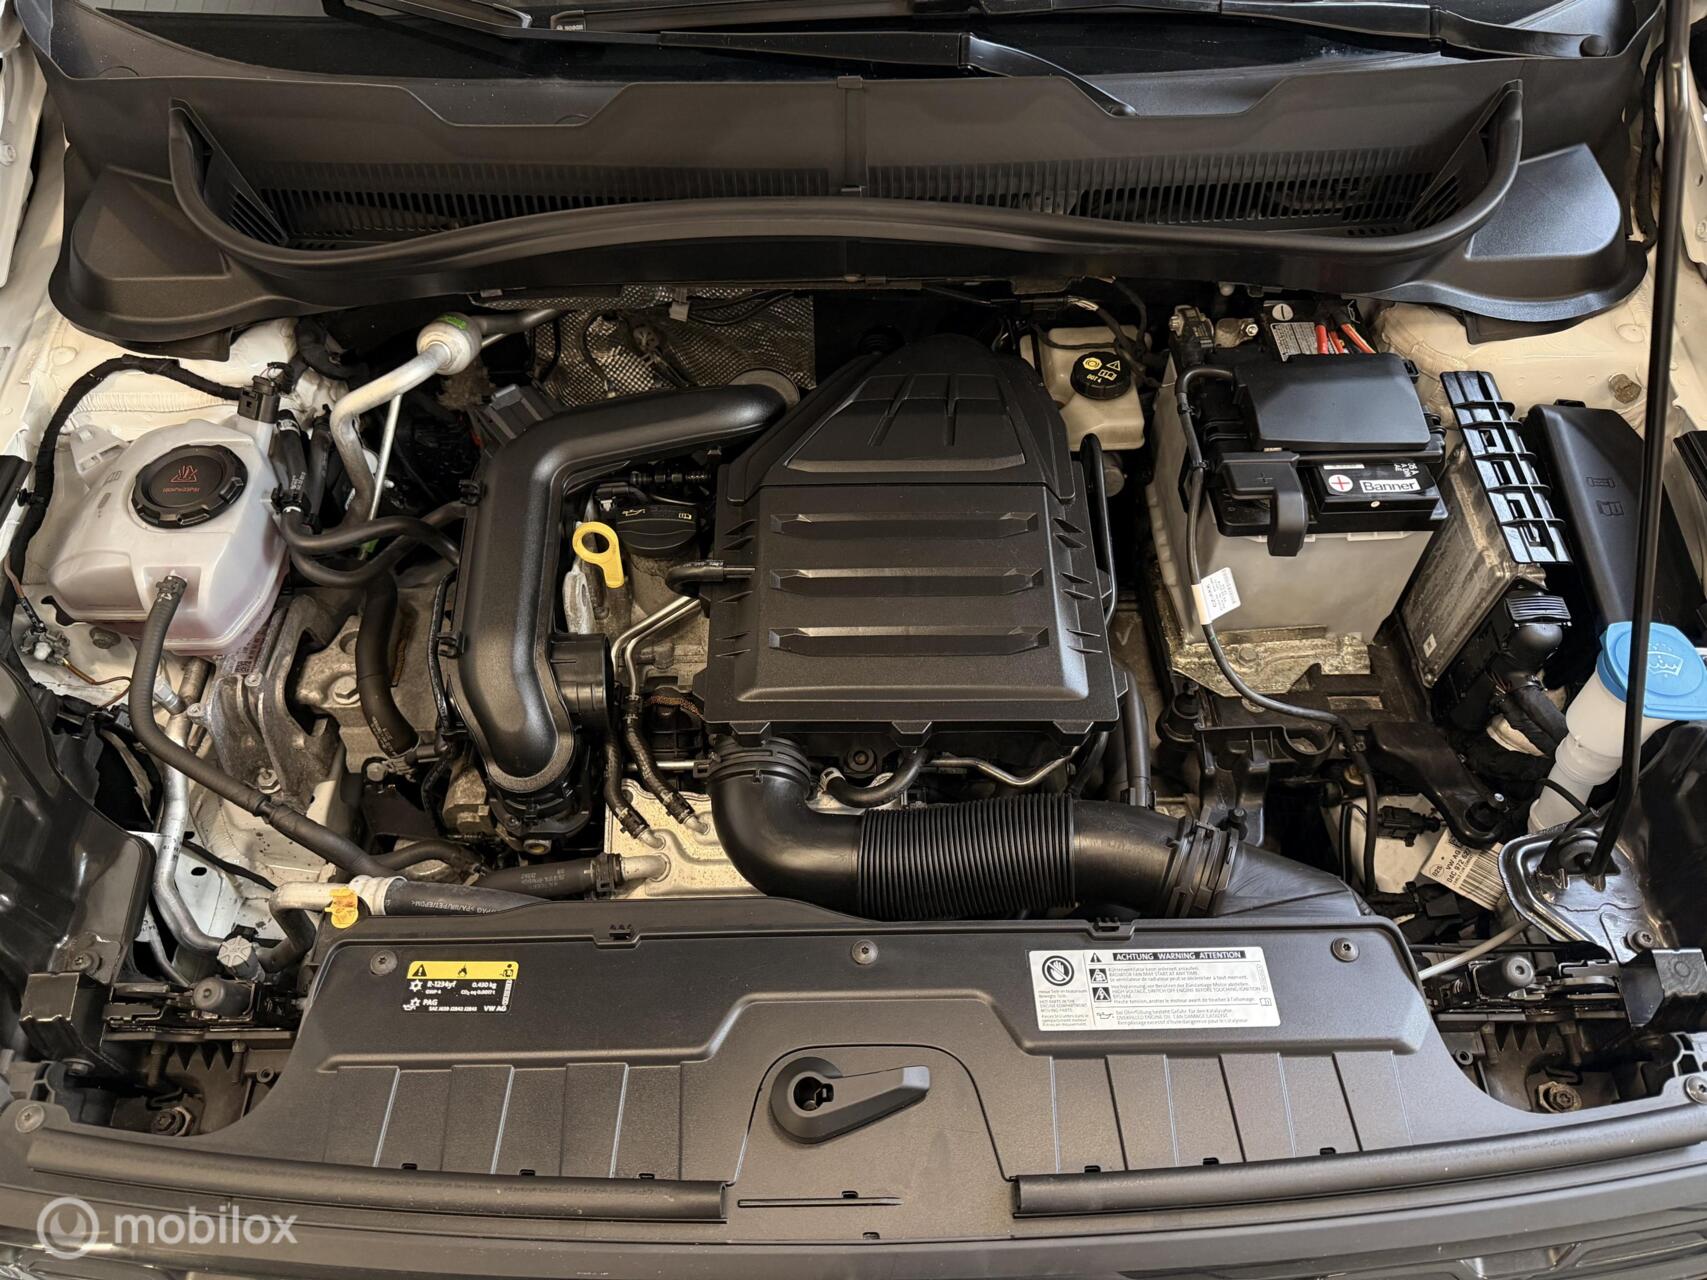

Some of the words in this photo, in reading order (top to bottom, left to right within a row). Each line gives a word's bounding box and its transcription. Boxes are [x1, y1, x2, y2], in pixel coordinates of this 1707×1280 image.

[1363, 481, 1416, 492] Banner
[1116, 952, 1154, 960] ACHTUNG
[1158, 952, 1196, 960] WARNING
[1200, 951, 1241, 959] ATTENTION
[427, 980, 457, 989] R-1234yf
